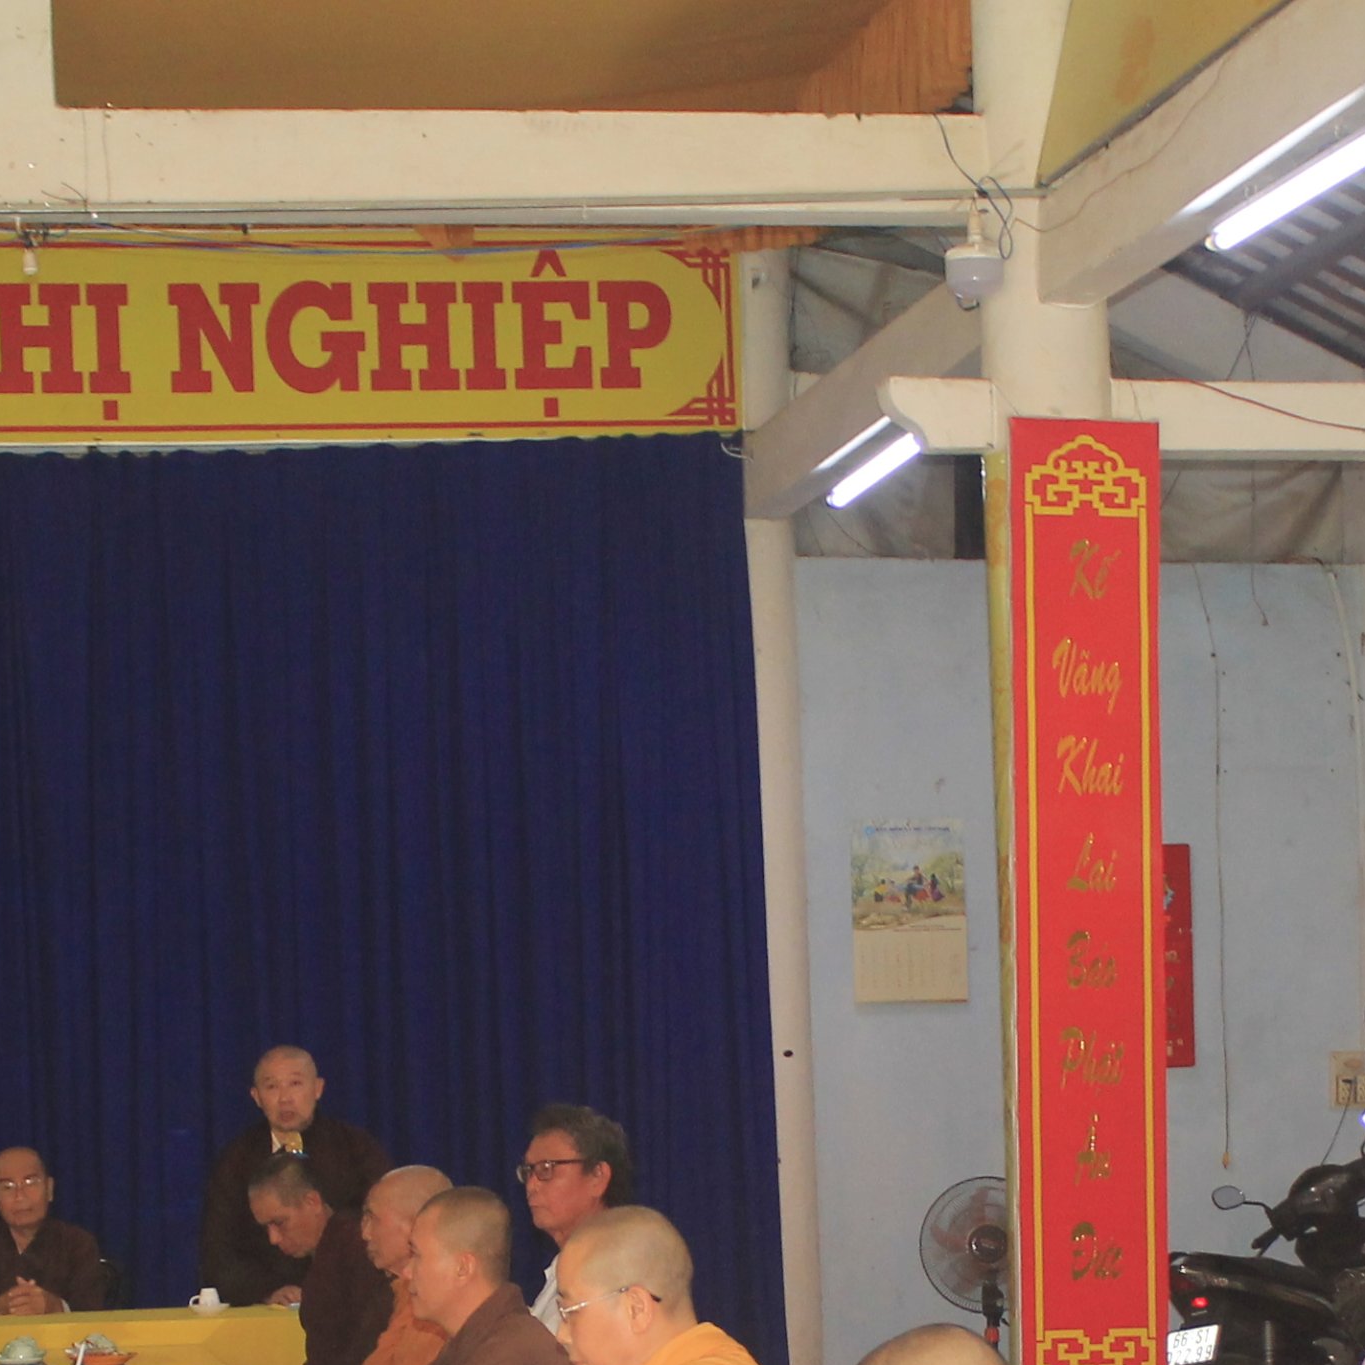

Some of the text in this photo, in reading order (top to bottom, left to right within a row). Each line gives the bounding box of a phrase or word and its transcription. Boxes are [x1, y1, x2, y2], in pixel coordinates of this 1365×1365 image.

[168, 248, 673, 418] NGHIỆP
[1052, 636, 1122, 714] Vãng
[1056, 735, 1124, 797] Khai
[1066, 831, 1117, 893] Lai
